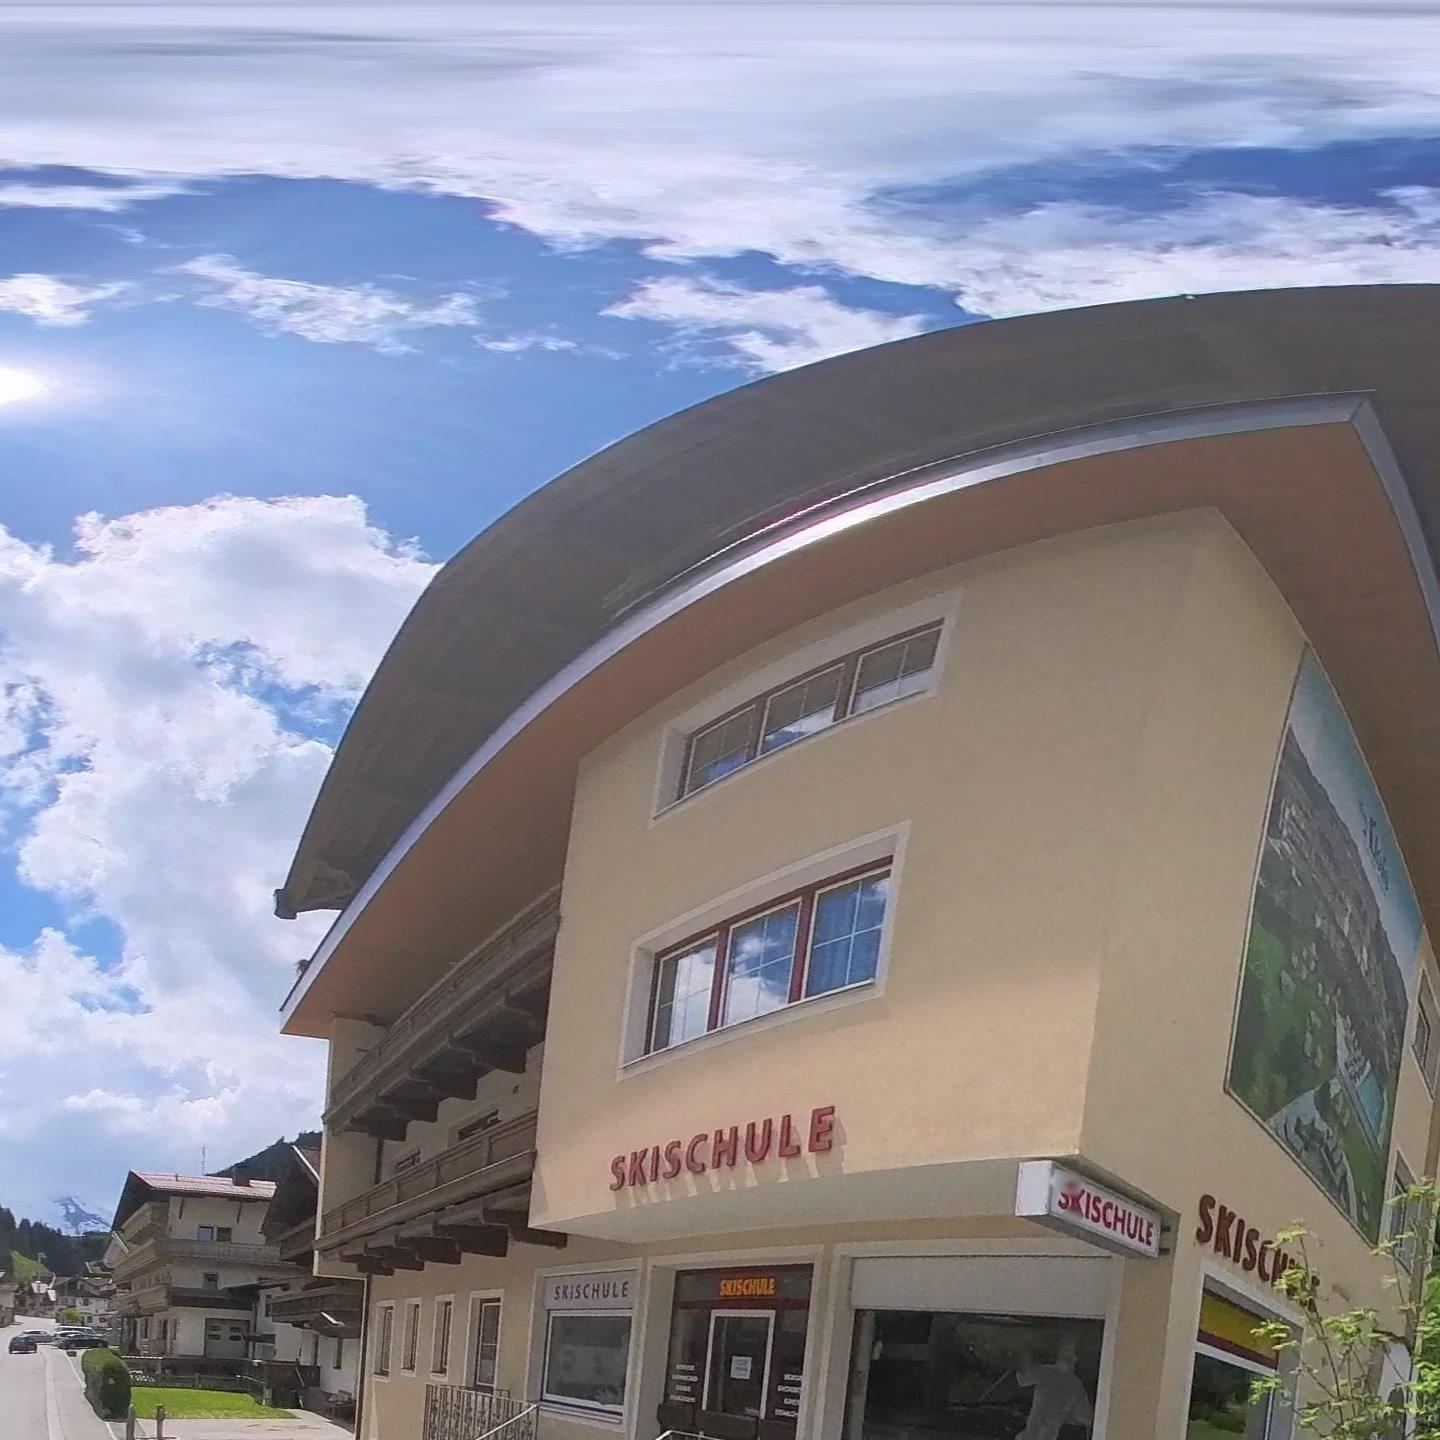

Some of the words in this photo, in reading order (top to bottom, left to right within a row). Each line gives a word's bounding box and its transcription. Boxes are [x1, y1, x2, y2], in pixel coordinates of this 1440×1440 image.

[609, 1105, 836, 1192] SKISCHULE
[1057, 1183, 1155, 1247] SKISCHULE
[1196, 1194, 1320, 1314] SKISCH
[554, 1281, 629, 1300] SKISCHULE
[719, 1277, 775, 1297] SKISCHULE
